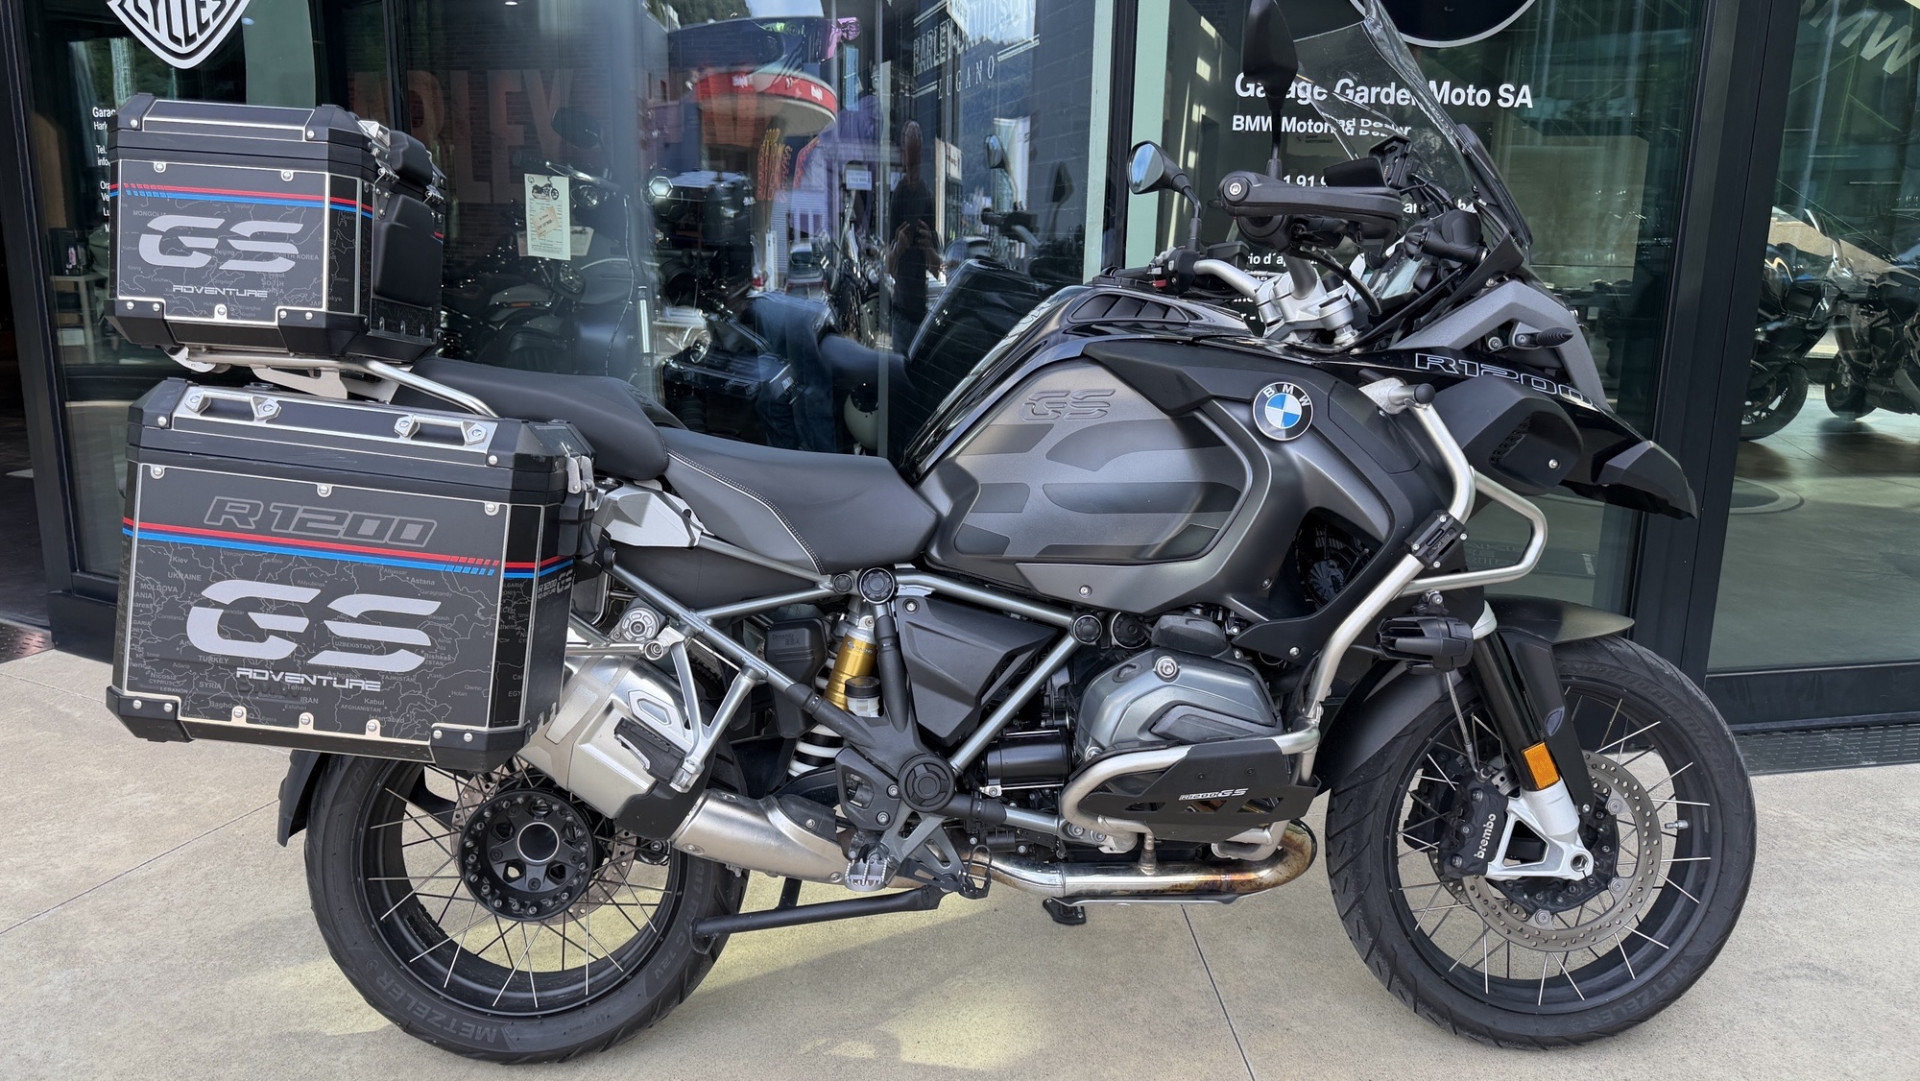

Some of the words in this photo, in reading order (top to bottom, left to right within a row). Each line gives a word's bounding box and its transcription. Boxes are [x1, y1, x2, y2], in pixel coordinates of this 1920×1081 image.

[938, 56, 995, 100] LUGANO
[1428, 81, 1491, 107] Moto
[1497, 83, 1534, 109] SA
[138, 213, 304, 274] GS
[172, 284, 269, 299] ADVENTURE
[1020, 388, 1117, 421] GS
[1263, 384, 1311, 407] BMW
[203, 495, 264, 531] R
[268, 502, 438, 548] 1200
[166, 571, 202, 582] UKRAINE
[410, 576, 436, 587] Astana
[186, 579, 442, 672] GS
[199, 681, 222, 690] SYRIA
[236, 667, 381, 692] ADVENTURE
[286, 683, 312, 693] Tehran
[300, 696, 319, 705] IRAN
[364, 697, 384, 706] Kabul
[1473, 813, 1497, 859] brembo
[376, 969, 499, 1044] METZELER
